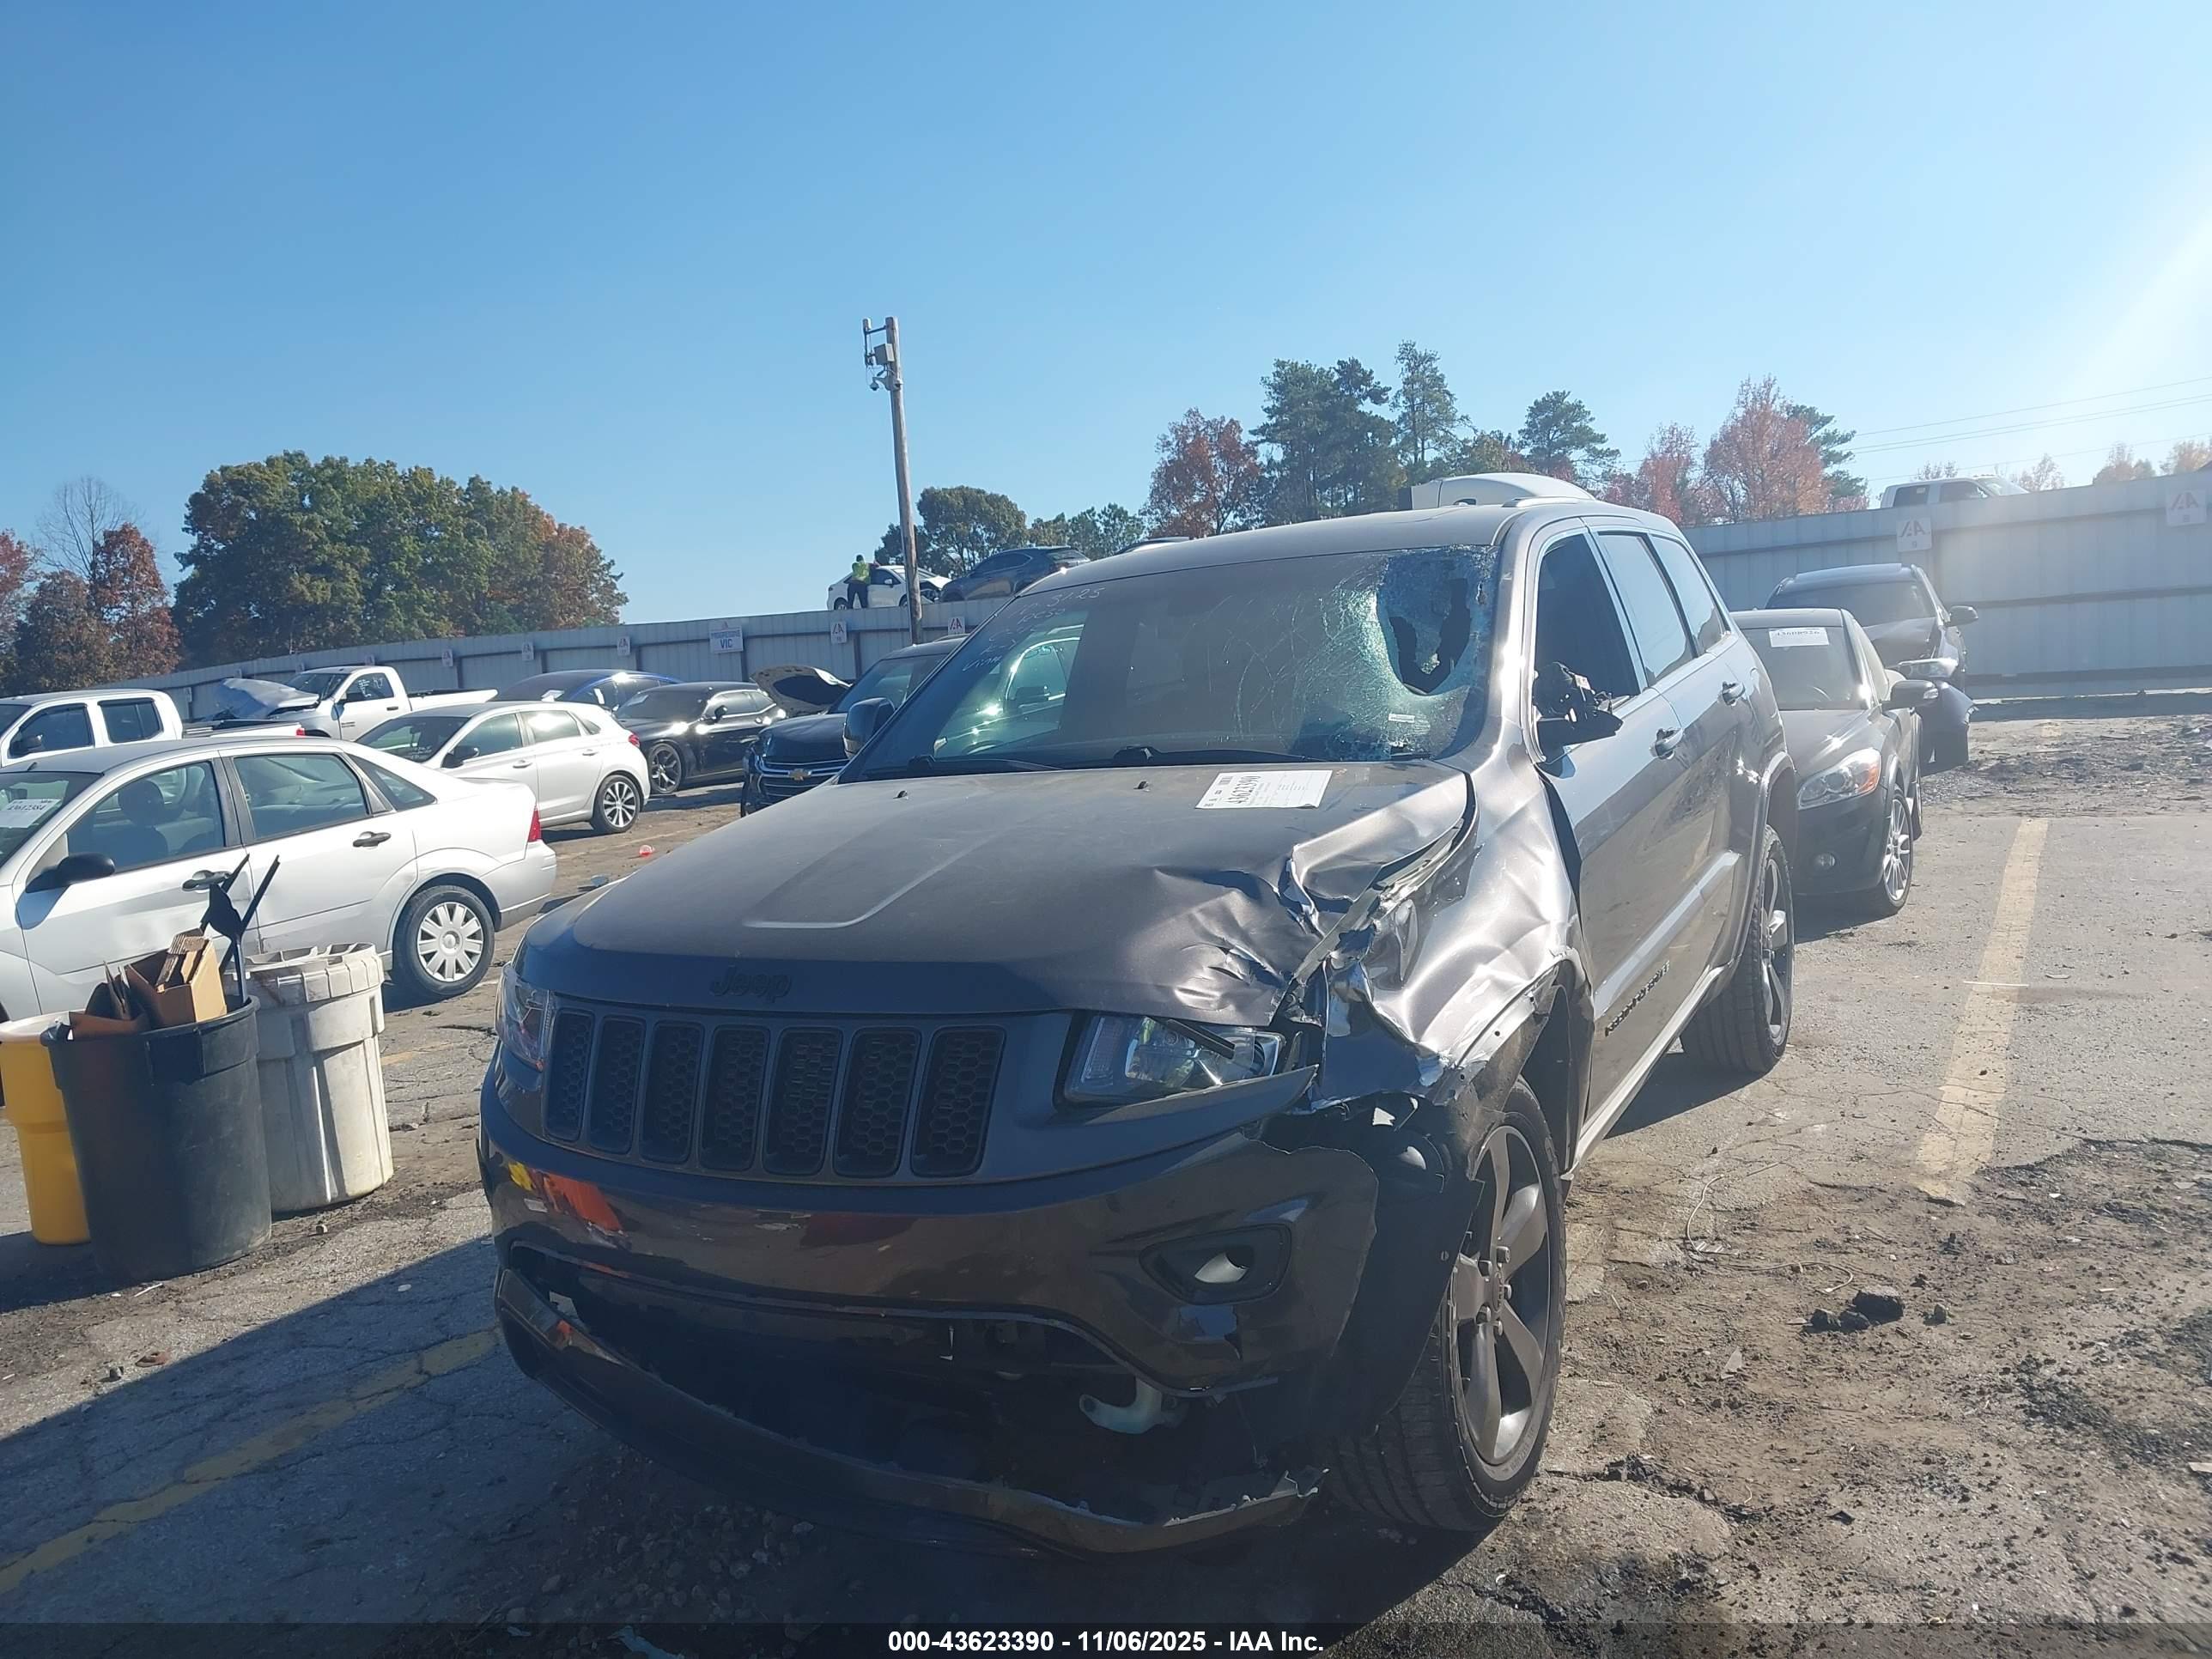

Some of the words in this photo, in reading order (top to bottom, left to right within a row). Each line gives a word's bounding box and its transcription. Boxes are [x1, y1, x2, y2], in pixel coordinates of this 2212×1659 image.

[720, 638, 733, 649] VIC
[1227, 776, 1261, 804] 43623390
[709, 964, 792, 1003] Jeep
